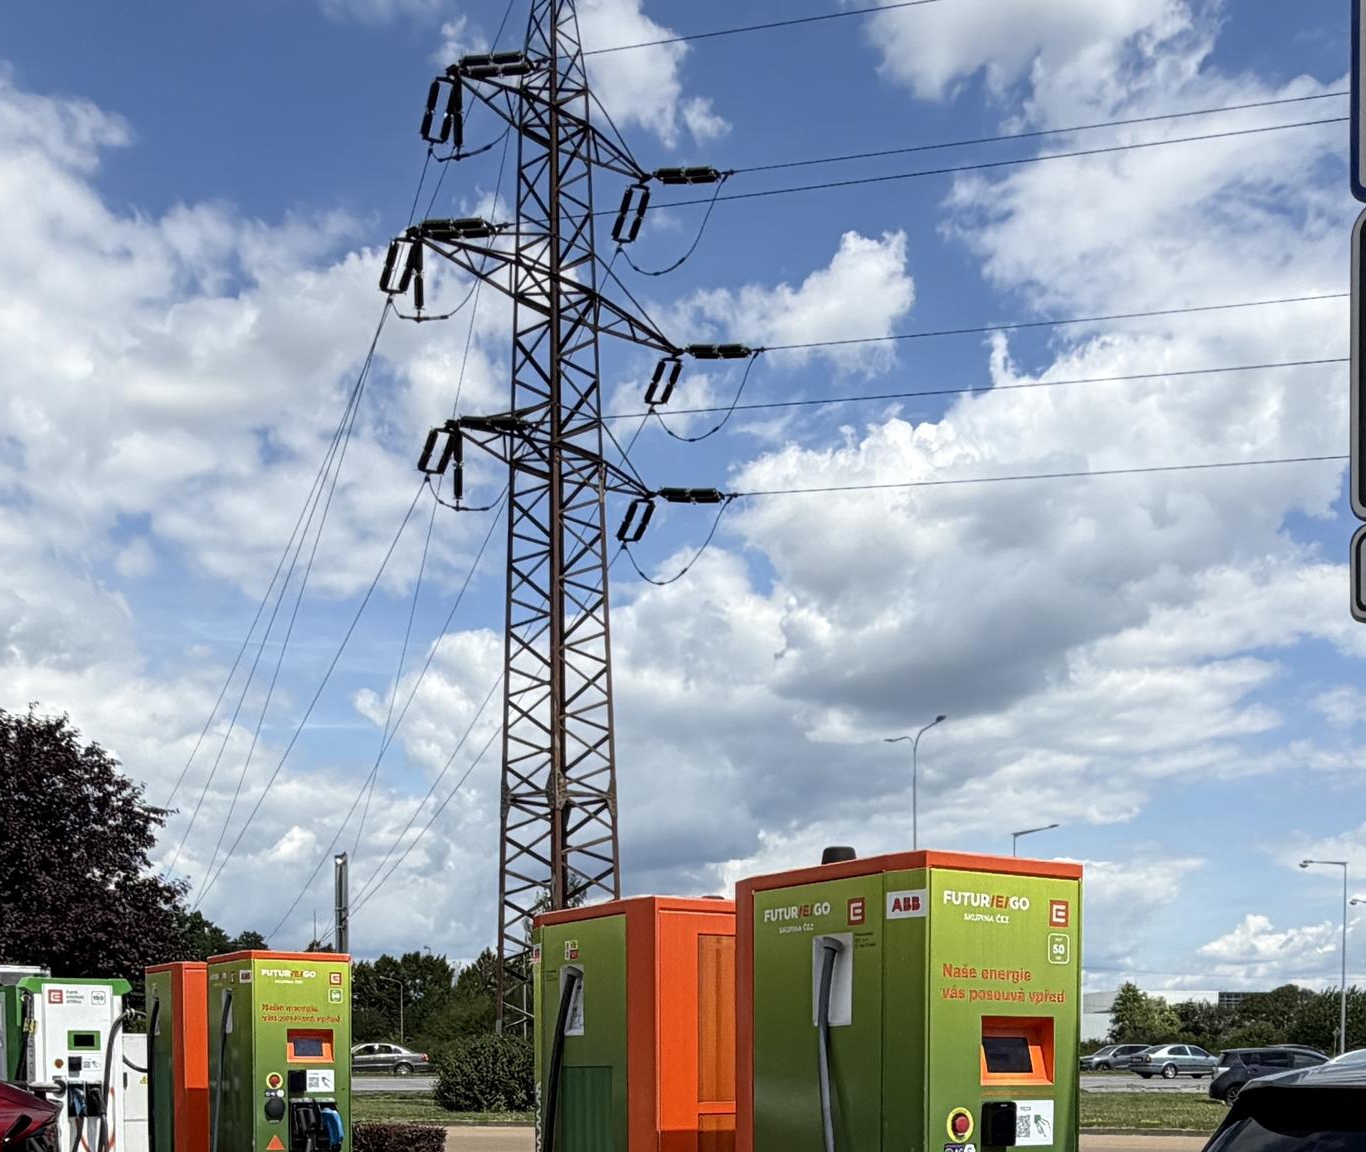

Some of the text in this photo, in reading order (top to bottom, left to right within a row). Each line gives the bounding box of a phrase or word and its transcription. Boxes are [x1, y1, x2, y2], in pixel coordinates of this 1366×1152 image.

[891, 896, 921, 913] ABB
[1052, 943, 1065, 955] 50
[942, 963, 1032, 984] Naše energie
